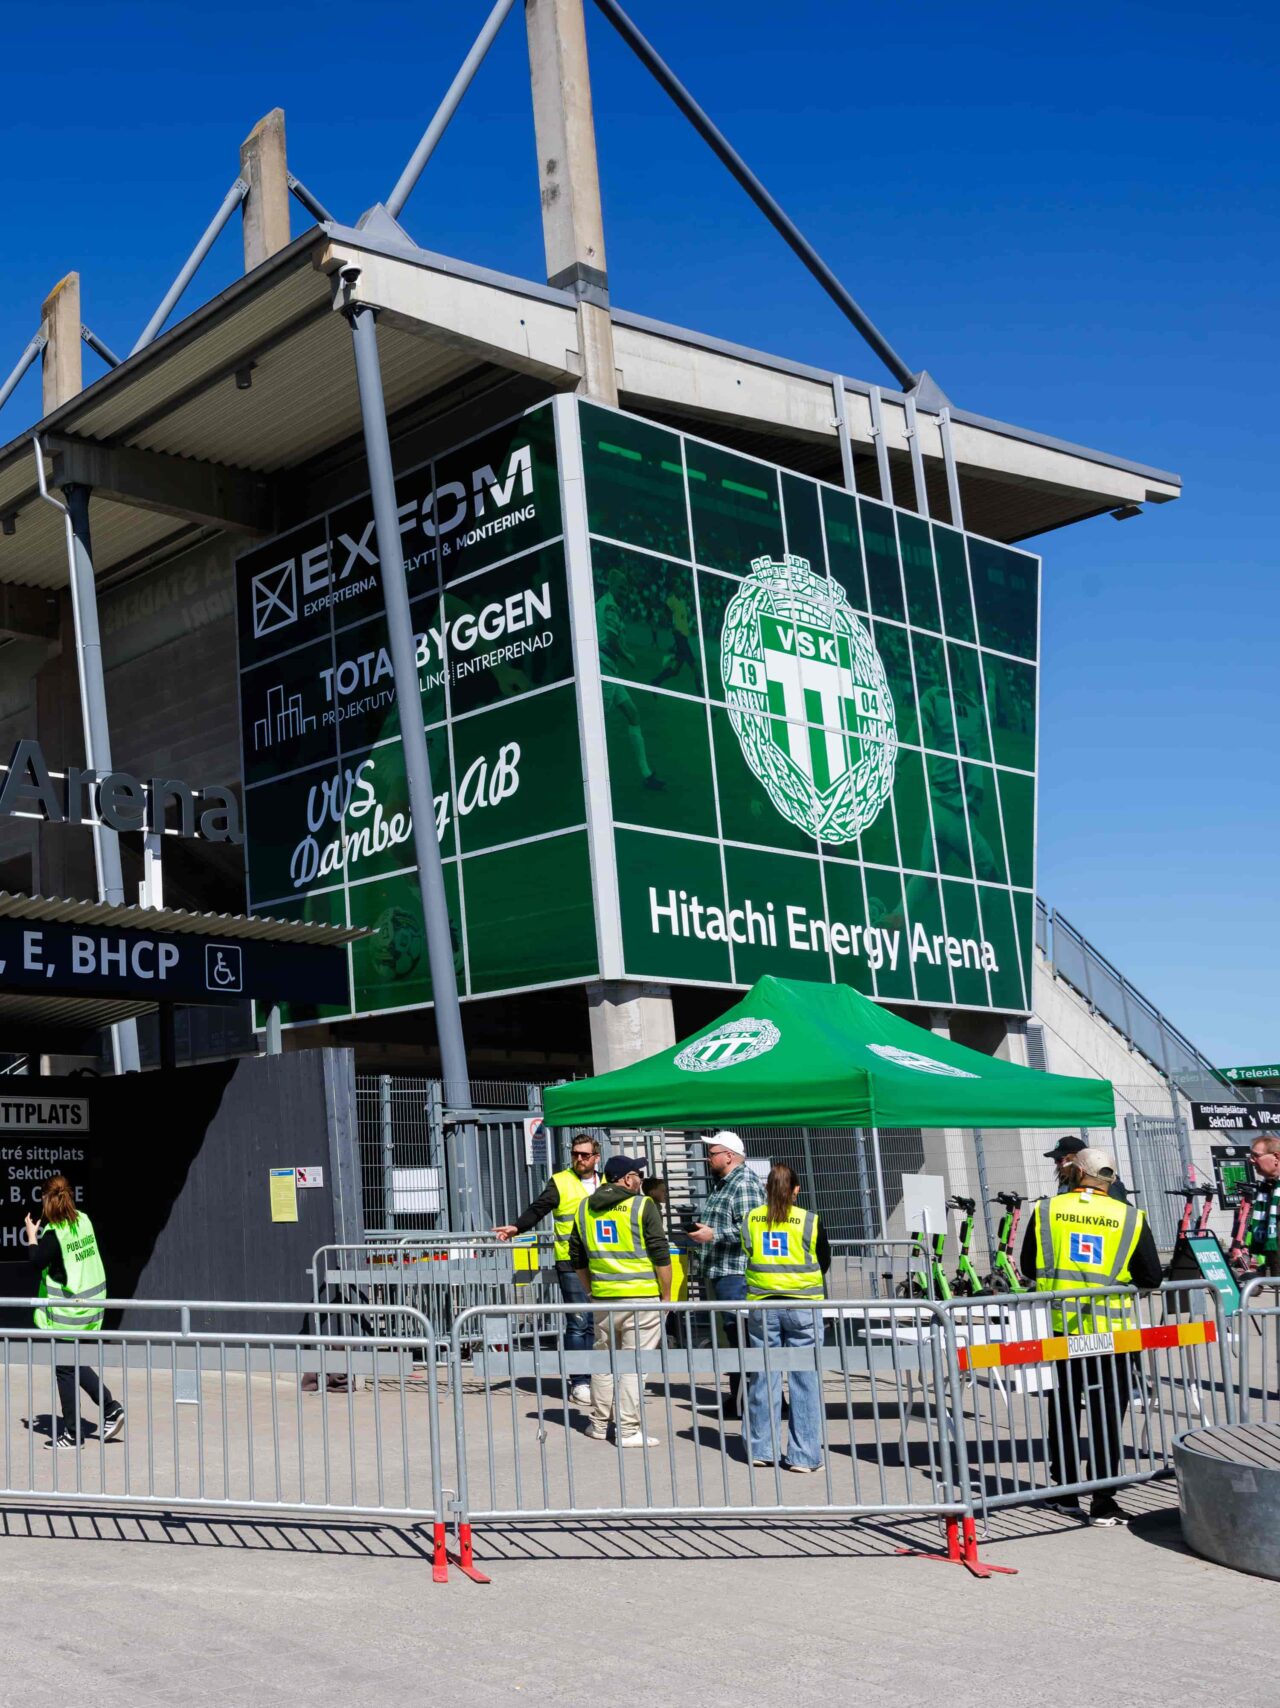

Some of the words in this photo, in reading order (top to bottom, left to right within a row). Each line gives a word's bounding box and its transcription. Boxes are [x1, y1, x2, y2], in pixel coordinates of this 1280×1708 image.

[304, 576, 377, 617] EXPERTERNA
[442, 542, 452, 556] &
[456, 504, 536, 550] MONTERING
[319, 582, 552, 701] TOTABYGGEN
[776, 625, 837, 662] VSK
[322, 668, 450, 727] PROJEKTUTVLING
[456, 631, 554, 679] ENTREPRENAD
[740, 661, 758, 686] 19
[862, 691, 879, 715] 04
[306, 759, 377, 832] VVS
[290, 791, 451, 888] Dambeg
[457, 741, 521, 815] AB
[649, 886, 777, 947] Hitachi
[786, 905, 900, 971] Energy
[912, 922, 999, 972] Arena
[23, 931, 55, 978] E,
[71, 935, 180, 980] BHCP
[1239, 1067, 1280, 1078] Telexia
[1208, 1116, 1235, 1128] Sektion
[1236, 1117, 1243, 1128] M
[26, 1146, 84, 1164] sittplats
[8, 1165, 61, 1180] Sektion
[10, 1186, 26, 1205] B,
[31, 1186, 42, 1203] C
[75, 1186, 84, 1202] E
[1056, 1212, 1119, 1229] PUBLIKVÄRD
[1068, 1333, 1113, 1355] ROCKLUNDA
